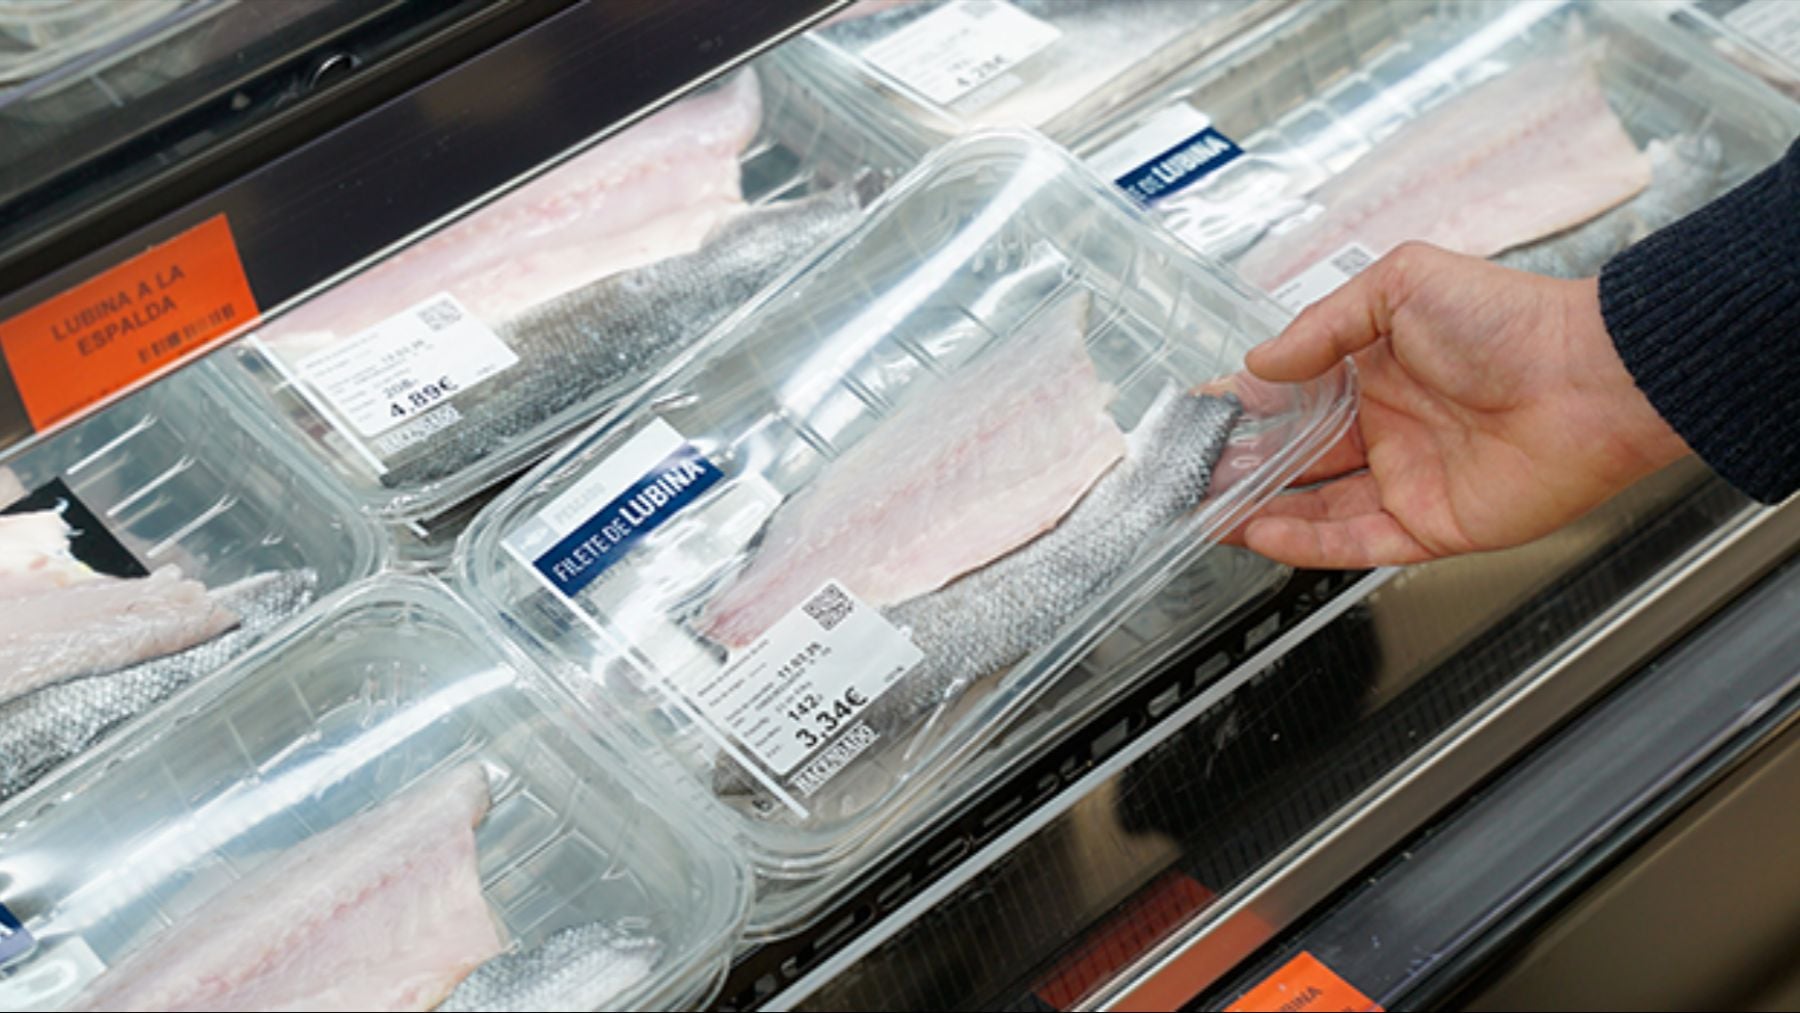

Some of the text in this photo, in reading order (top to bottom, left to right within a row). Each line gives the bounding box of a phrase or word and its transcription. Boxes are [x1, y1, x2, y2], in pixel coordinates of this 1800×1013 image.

[1151, 135, 1231, 183] LUBINA
[51, 291, 132, 341] LUBINA
[138, 280, 153, 299] A
[156, 264, 186, 289] LA
[76, 295, 177, 356] ESPALDA
[552, 533, 607, 583] FILETE
[602, 517, 632, 543] DE
[618, 459, 706, 527] LUBINA
[795, 686, 869, 748] 3,34€
